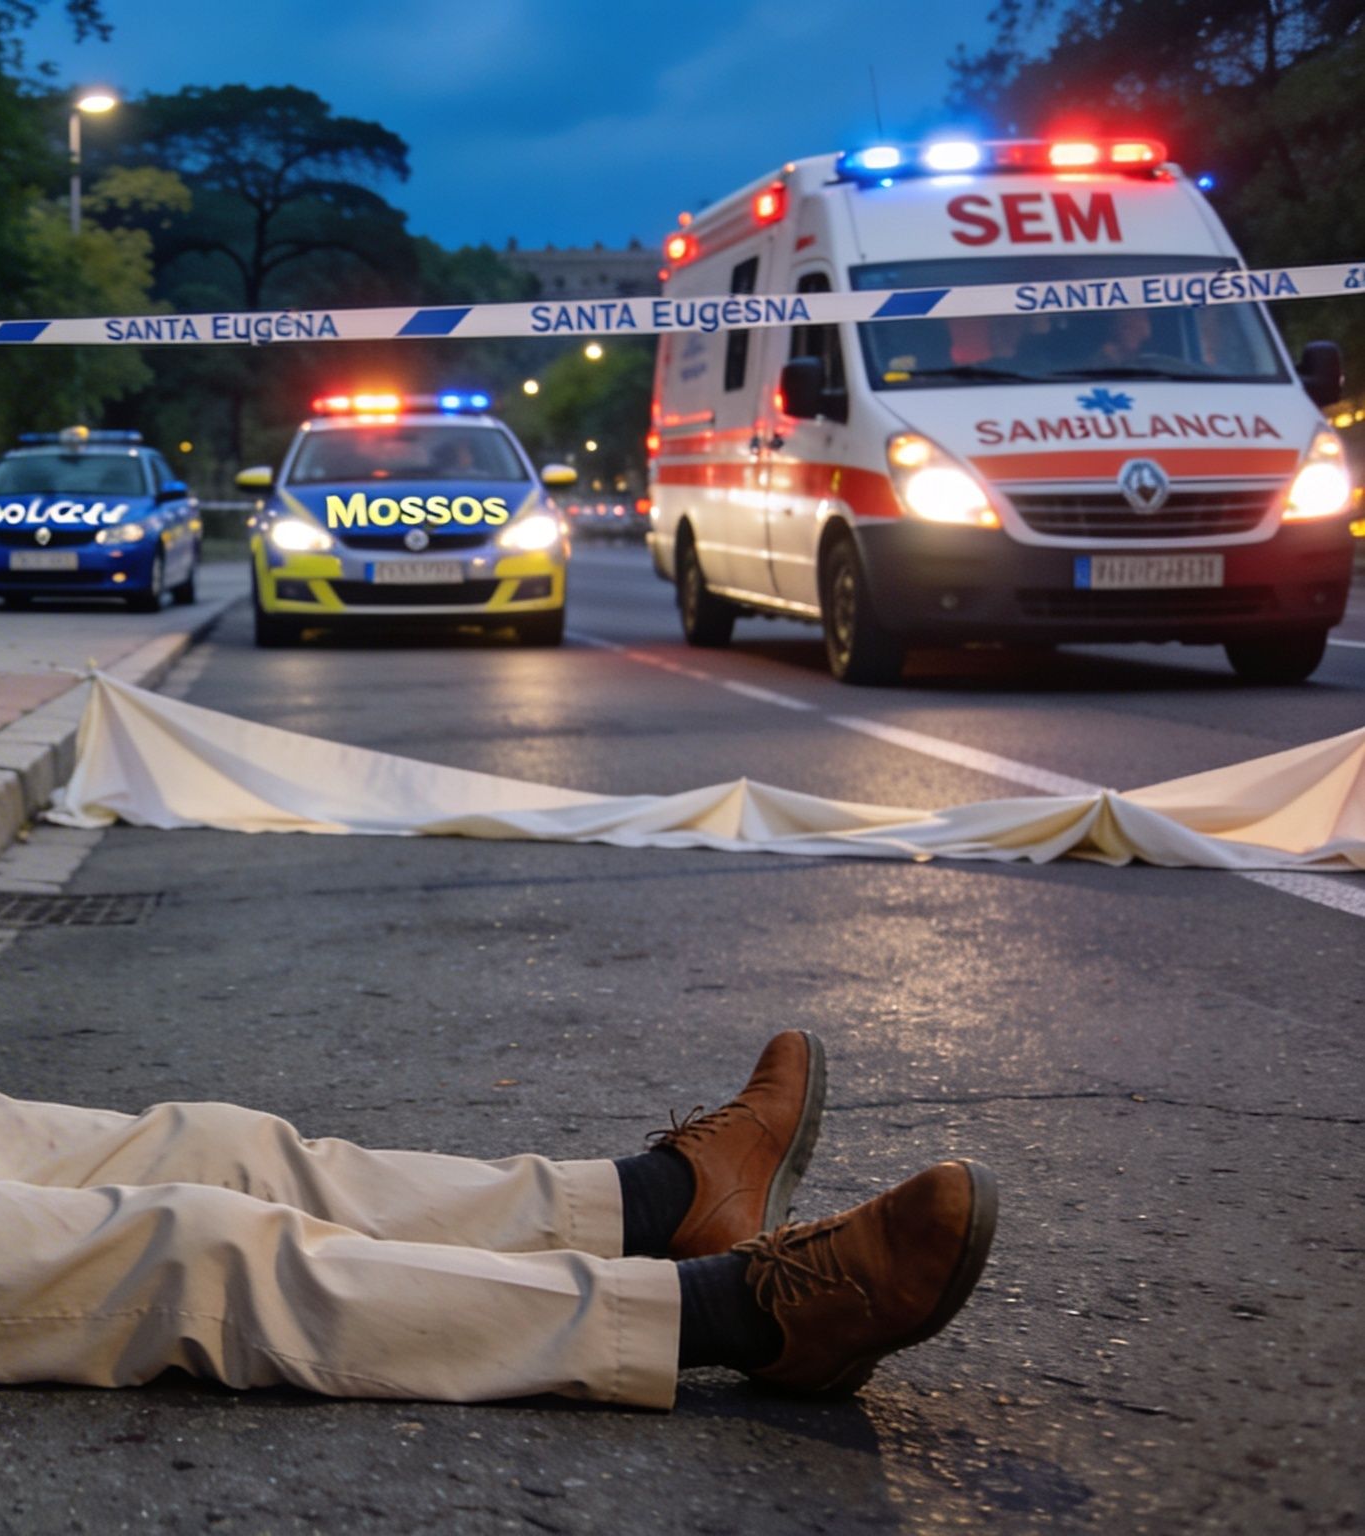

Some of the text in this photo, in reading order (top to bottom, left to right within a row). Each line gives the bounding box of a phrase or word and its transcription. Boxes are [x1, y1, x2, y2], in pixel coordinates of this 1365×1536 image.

[945, 192, 1123, 247] SEM
[1014, 283, 1129, 311] SANTA
[105, 318, 200, 341] SANTA
[530, 304, 636, 333] SANTA
